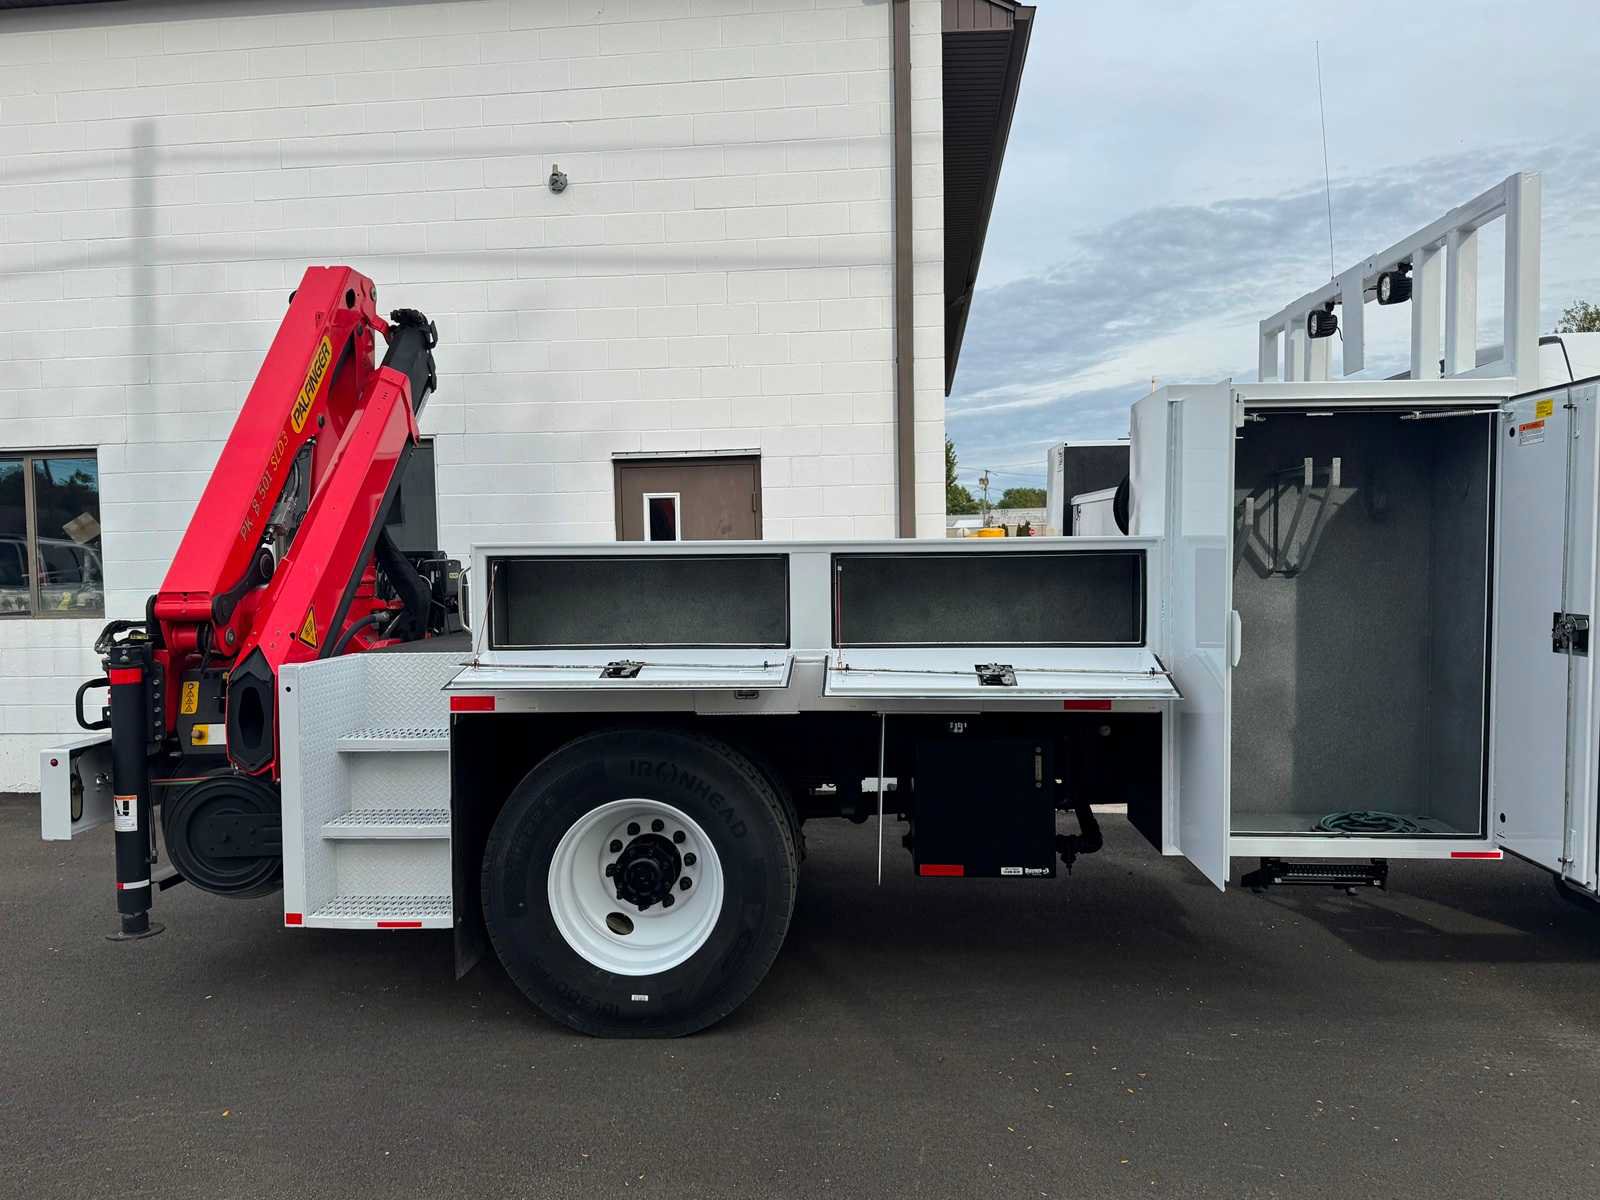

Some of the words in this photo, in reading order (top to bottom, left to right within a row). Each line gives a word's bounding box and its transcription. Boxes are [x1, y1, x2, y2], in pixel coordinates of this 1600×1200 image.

[293, 342, 330, 428] PALFINGER
[240, 519, 254, 542] PK
[628, 757, 749, 840] IRONHEAD
